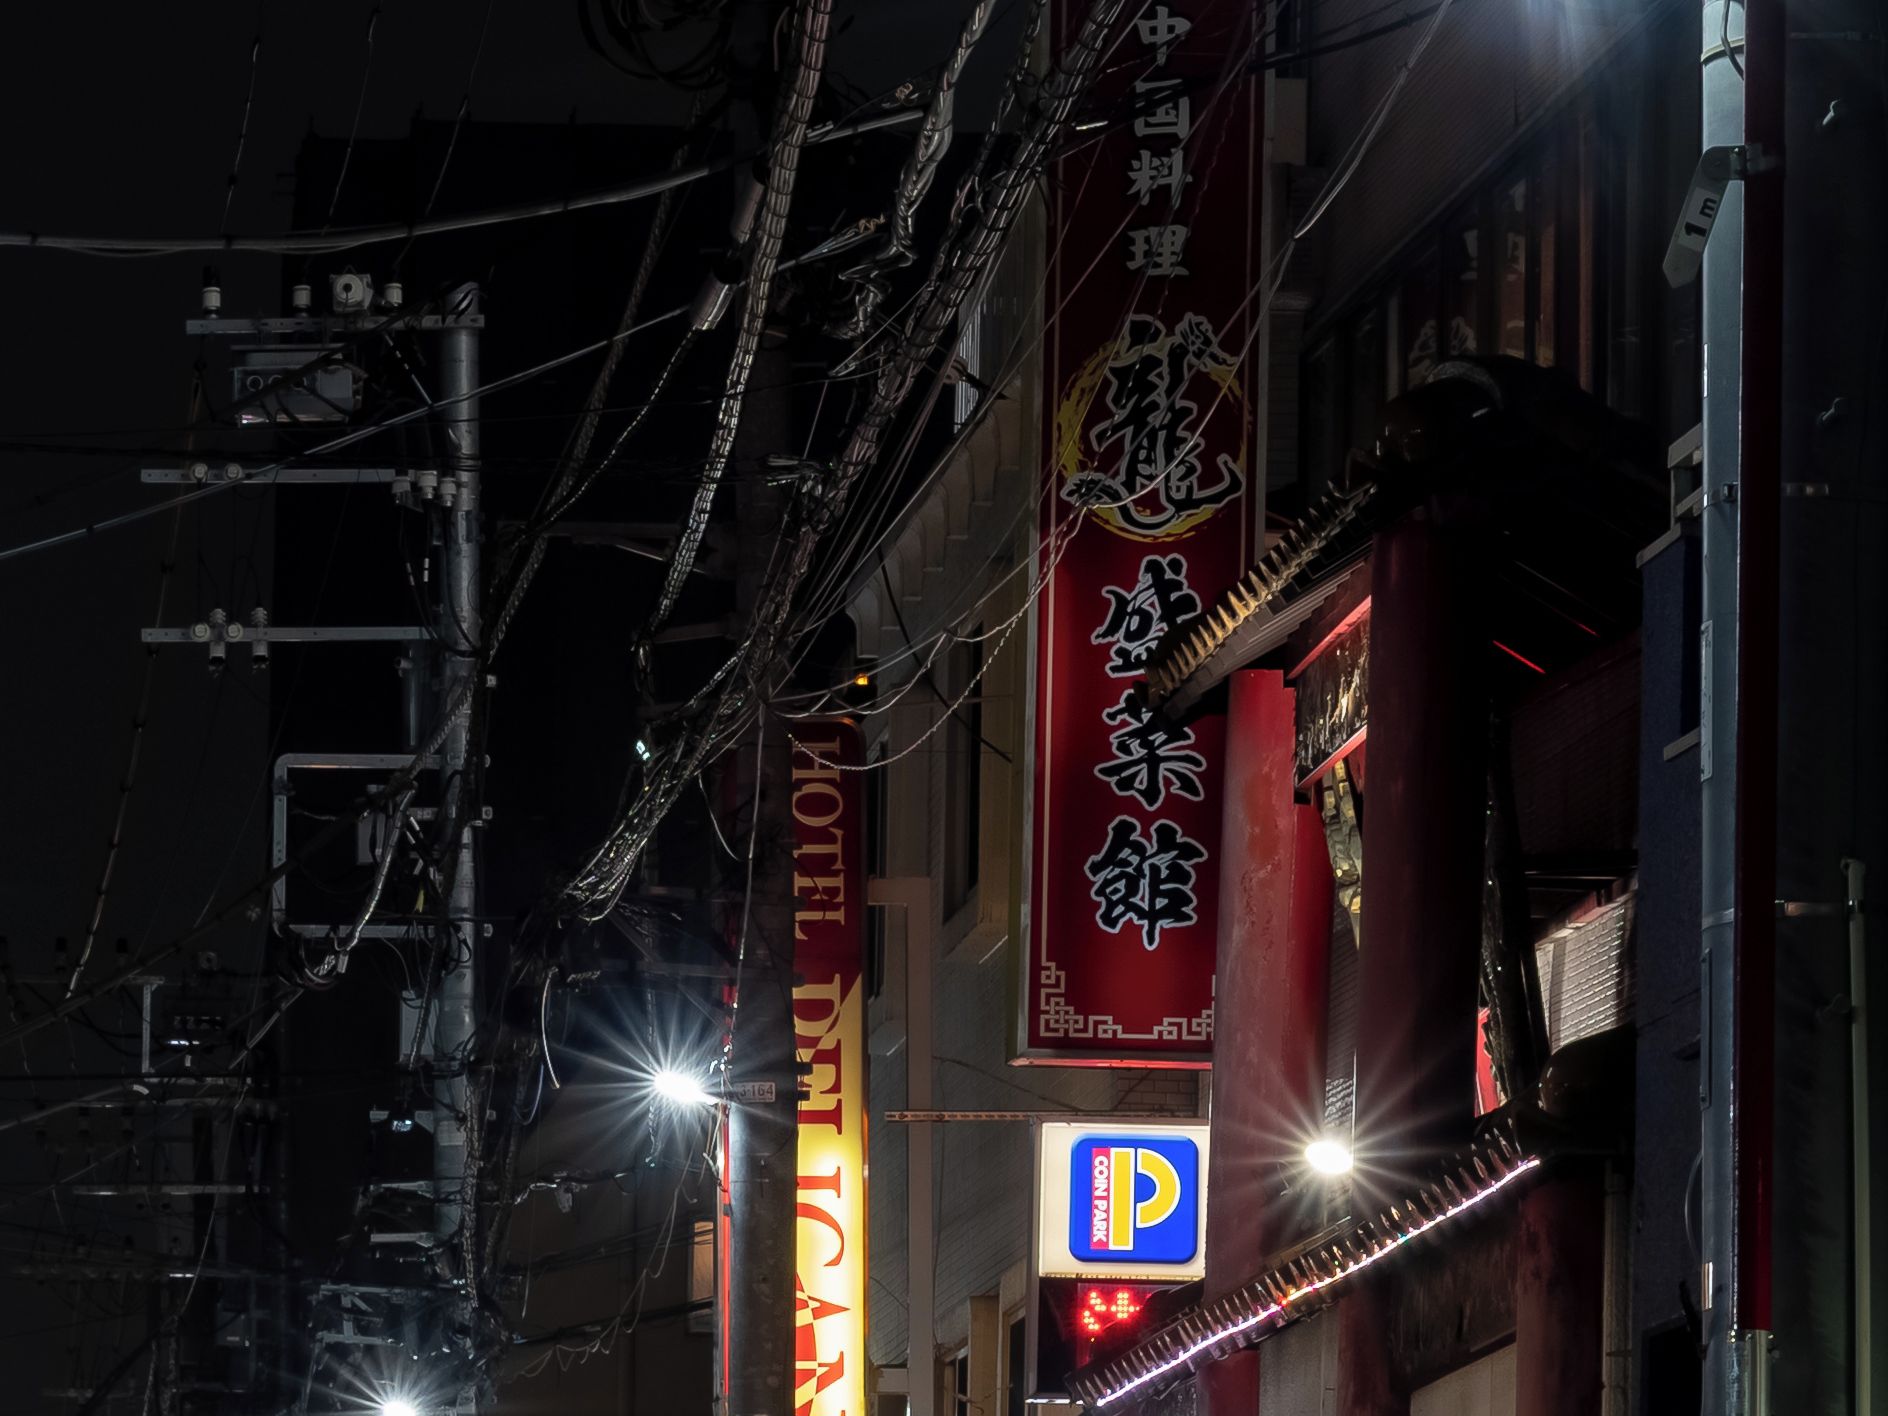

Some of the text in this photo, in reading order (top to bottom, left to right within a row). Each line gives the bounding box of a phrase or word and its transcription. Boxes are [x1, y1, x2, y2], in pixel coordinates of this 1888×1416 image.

[1126, 6, 1193, 277] 中国料理
[792, 738, 845, 939] HOTEL
[1094, 1155, 1108, 1242] COIN PARK
